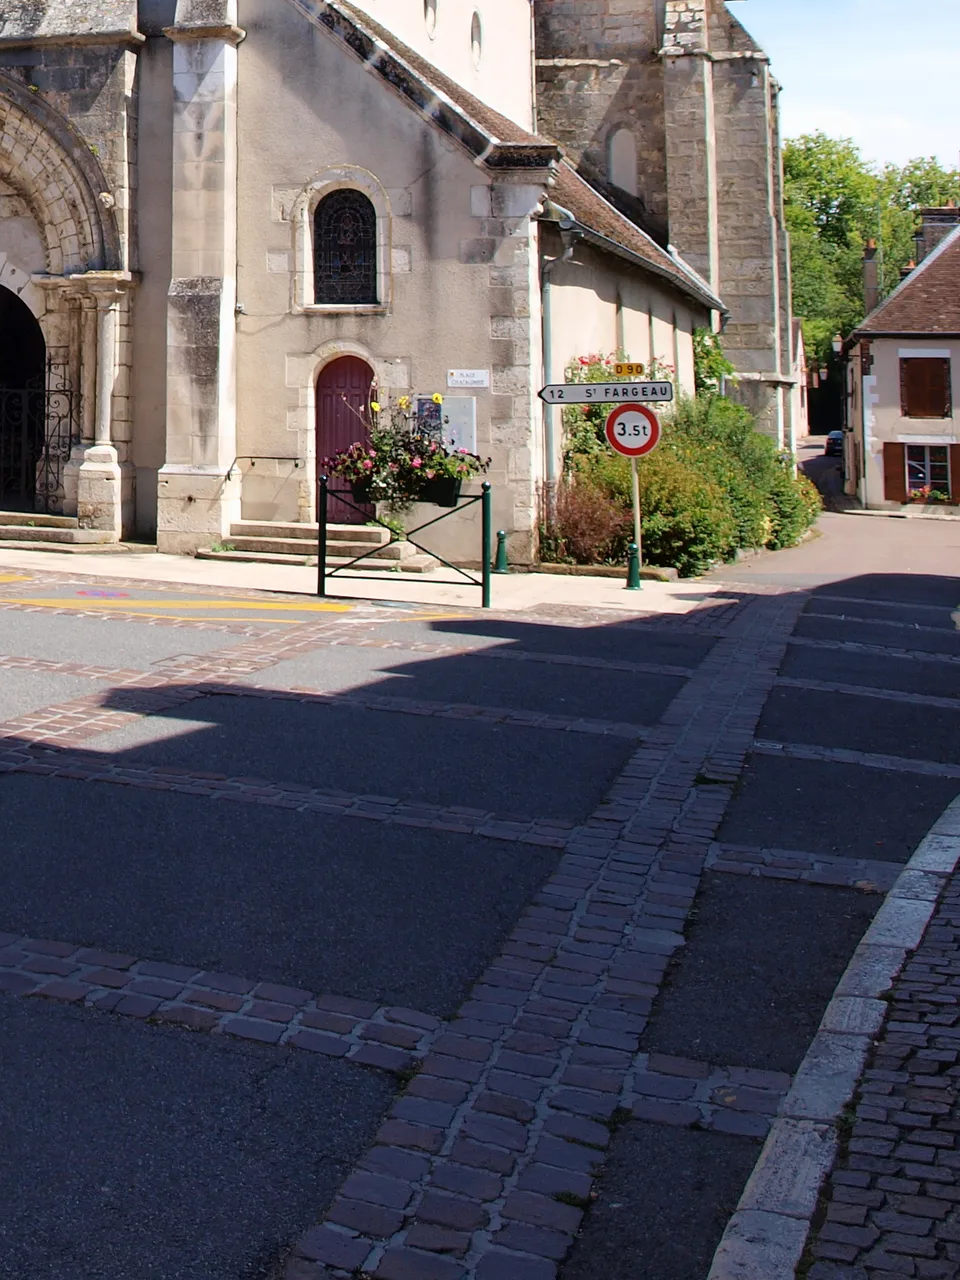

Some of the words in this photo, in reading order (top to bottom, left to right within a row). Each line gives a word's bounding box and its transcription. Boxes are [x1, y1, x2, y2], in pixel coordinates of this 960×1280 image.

[615, 364, 623, 374] D
[627, 364, 643, 374] 90
[549, 389, 564, 399] 12
[604, 386, 668, 397] FARGEAU
[617, 422, 648, 436] 3.5t
